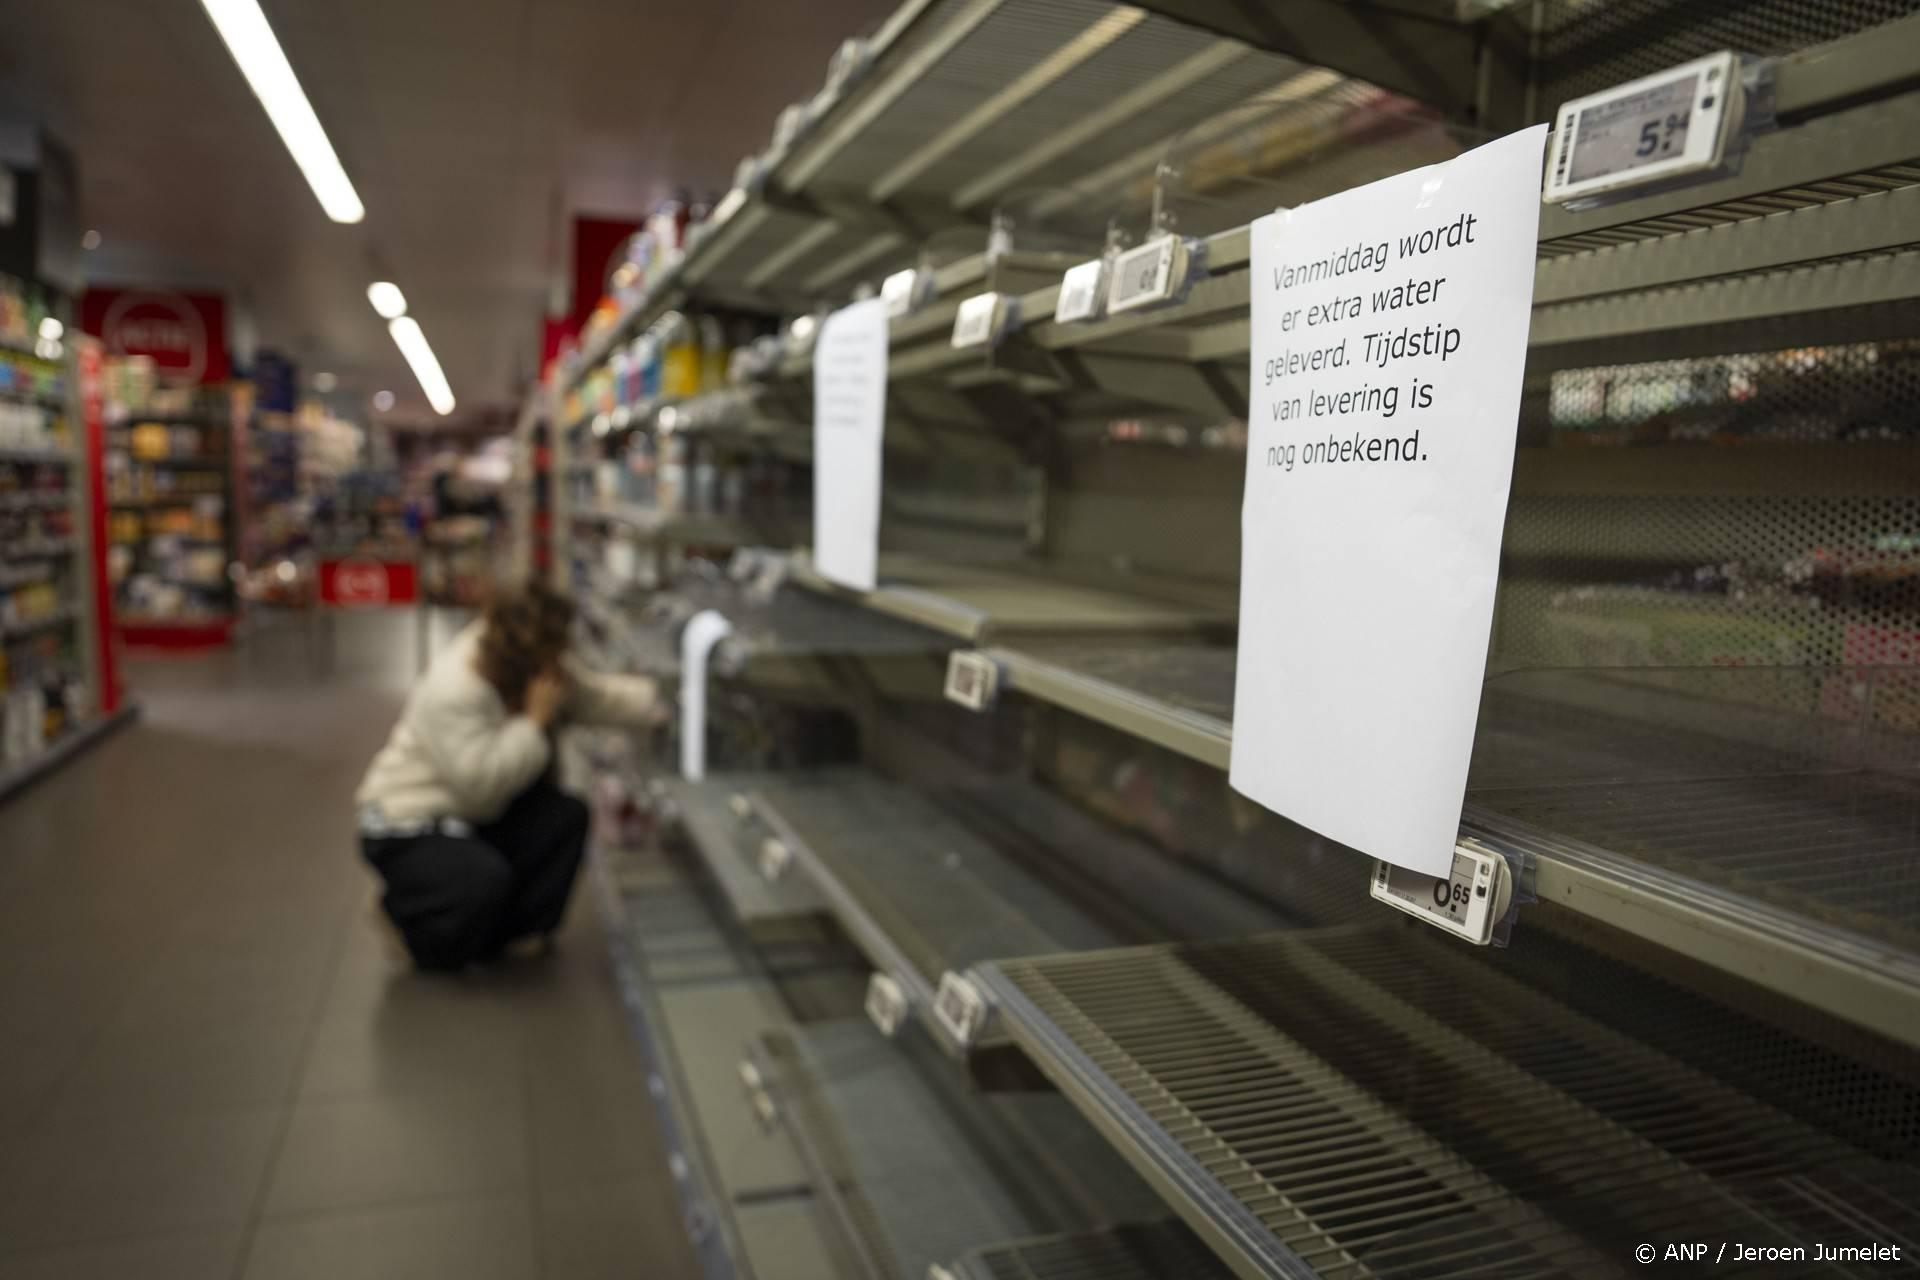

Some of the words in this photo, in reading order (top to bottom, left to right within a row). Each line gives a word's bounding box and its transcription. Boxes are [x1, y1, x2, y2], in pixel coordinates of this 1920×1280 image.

[1273, 242, 1389, 291] Vanmiddag
[1399, 213, 1477, 259] wordt
[1281, 308, 1301, 332] er
[1307, 296, 1362, 326] extra
[1372, 278, 1446, 313] water
[1265, 338, 1350, 386] geleverd.
[1363, 323, 1461, 368] Tijdstip
[1272, 397, 1301, 421] van
[1308, 383, 1399, 417] levering
[1411, 378, 1434, 409] is
[1267, 444, 1296, 472] nog
[1302, 429, 1427, 464] onbekend.
